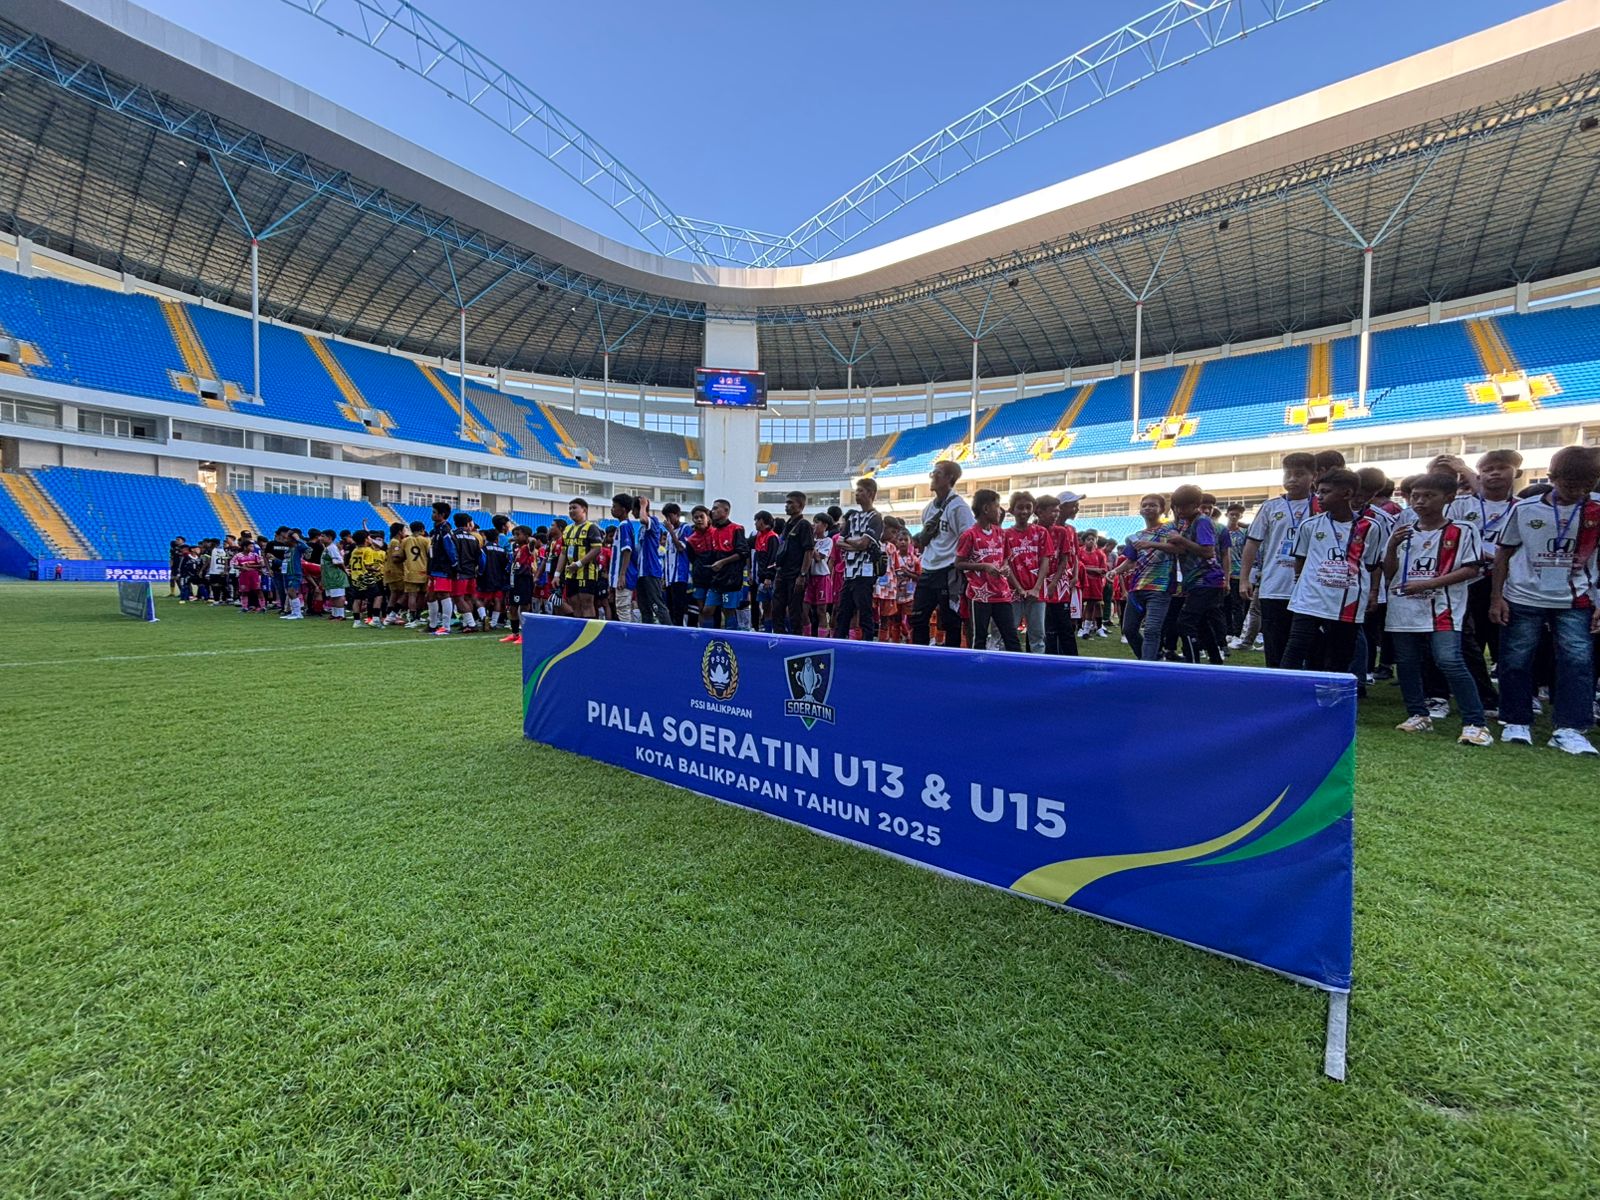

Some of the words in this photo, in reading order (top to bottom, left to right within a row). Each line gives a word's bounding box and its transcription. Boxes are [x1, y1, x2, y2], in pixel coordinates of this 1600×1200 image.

[410, 545, 420, 562] 9
[710, 656, 729, 666] PSSI
[690, 699, 706, 710] PSSI
[706, 703, 753, 719] BALIKPAPAN
[787, 701, 832, 721] SOERATIN
[587, 700, 654, 737] PIALA
[662, 716, 819, 778] SOERATIN
[834, 752, 904, 799] U13
[921, 773, 951, 811] &
[970, 782, 1067, 839] U15
[635, 746, 674, 770] KOTA
[679, 757, 787, 802] BALIKPAPAN
[794, 788, 870, 826] TAHUN
[878, 812, 941, 846] 2025
